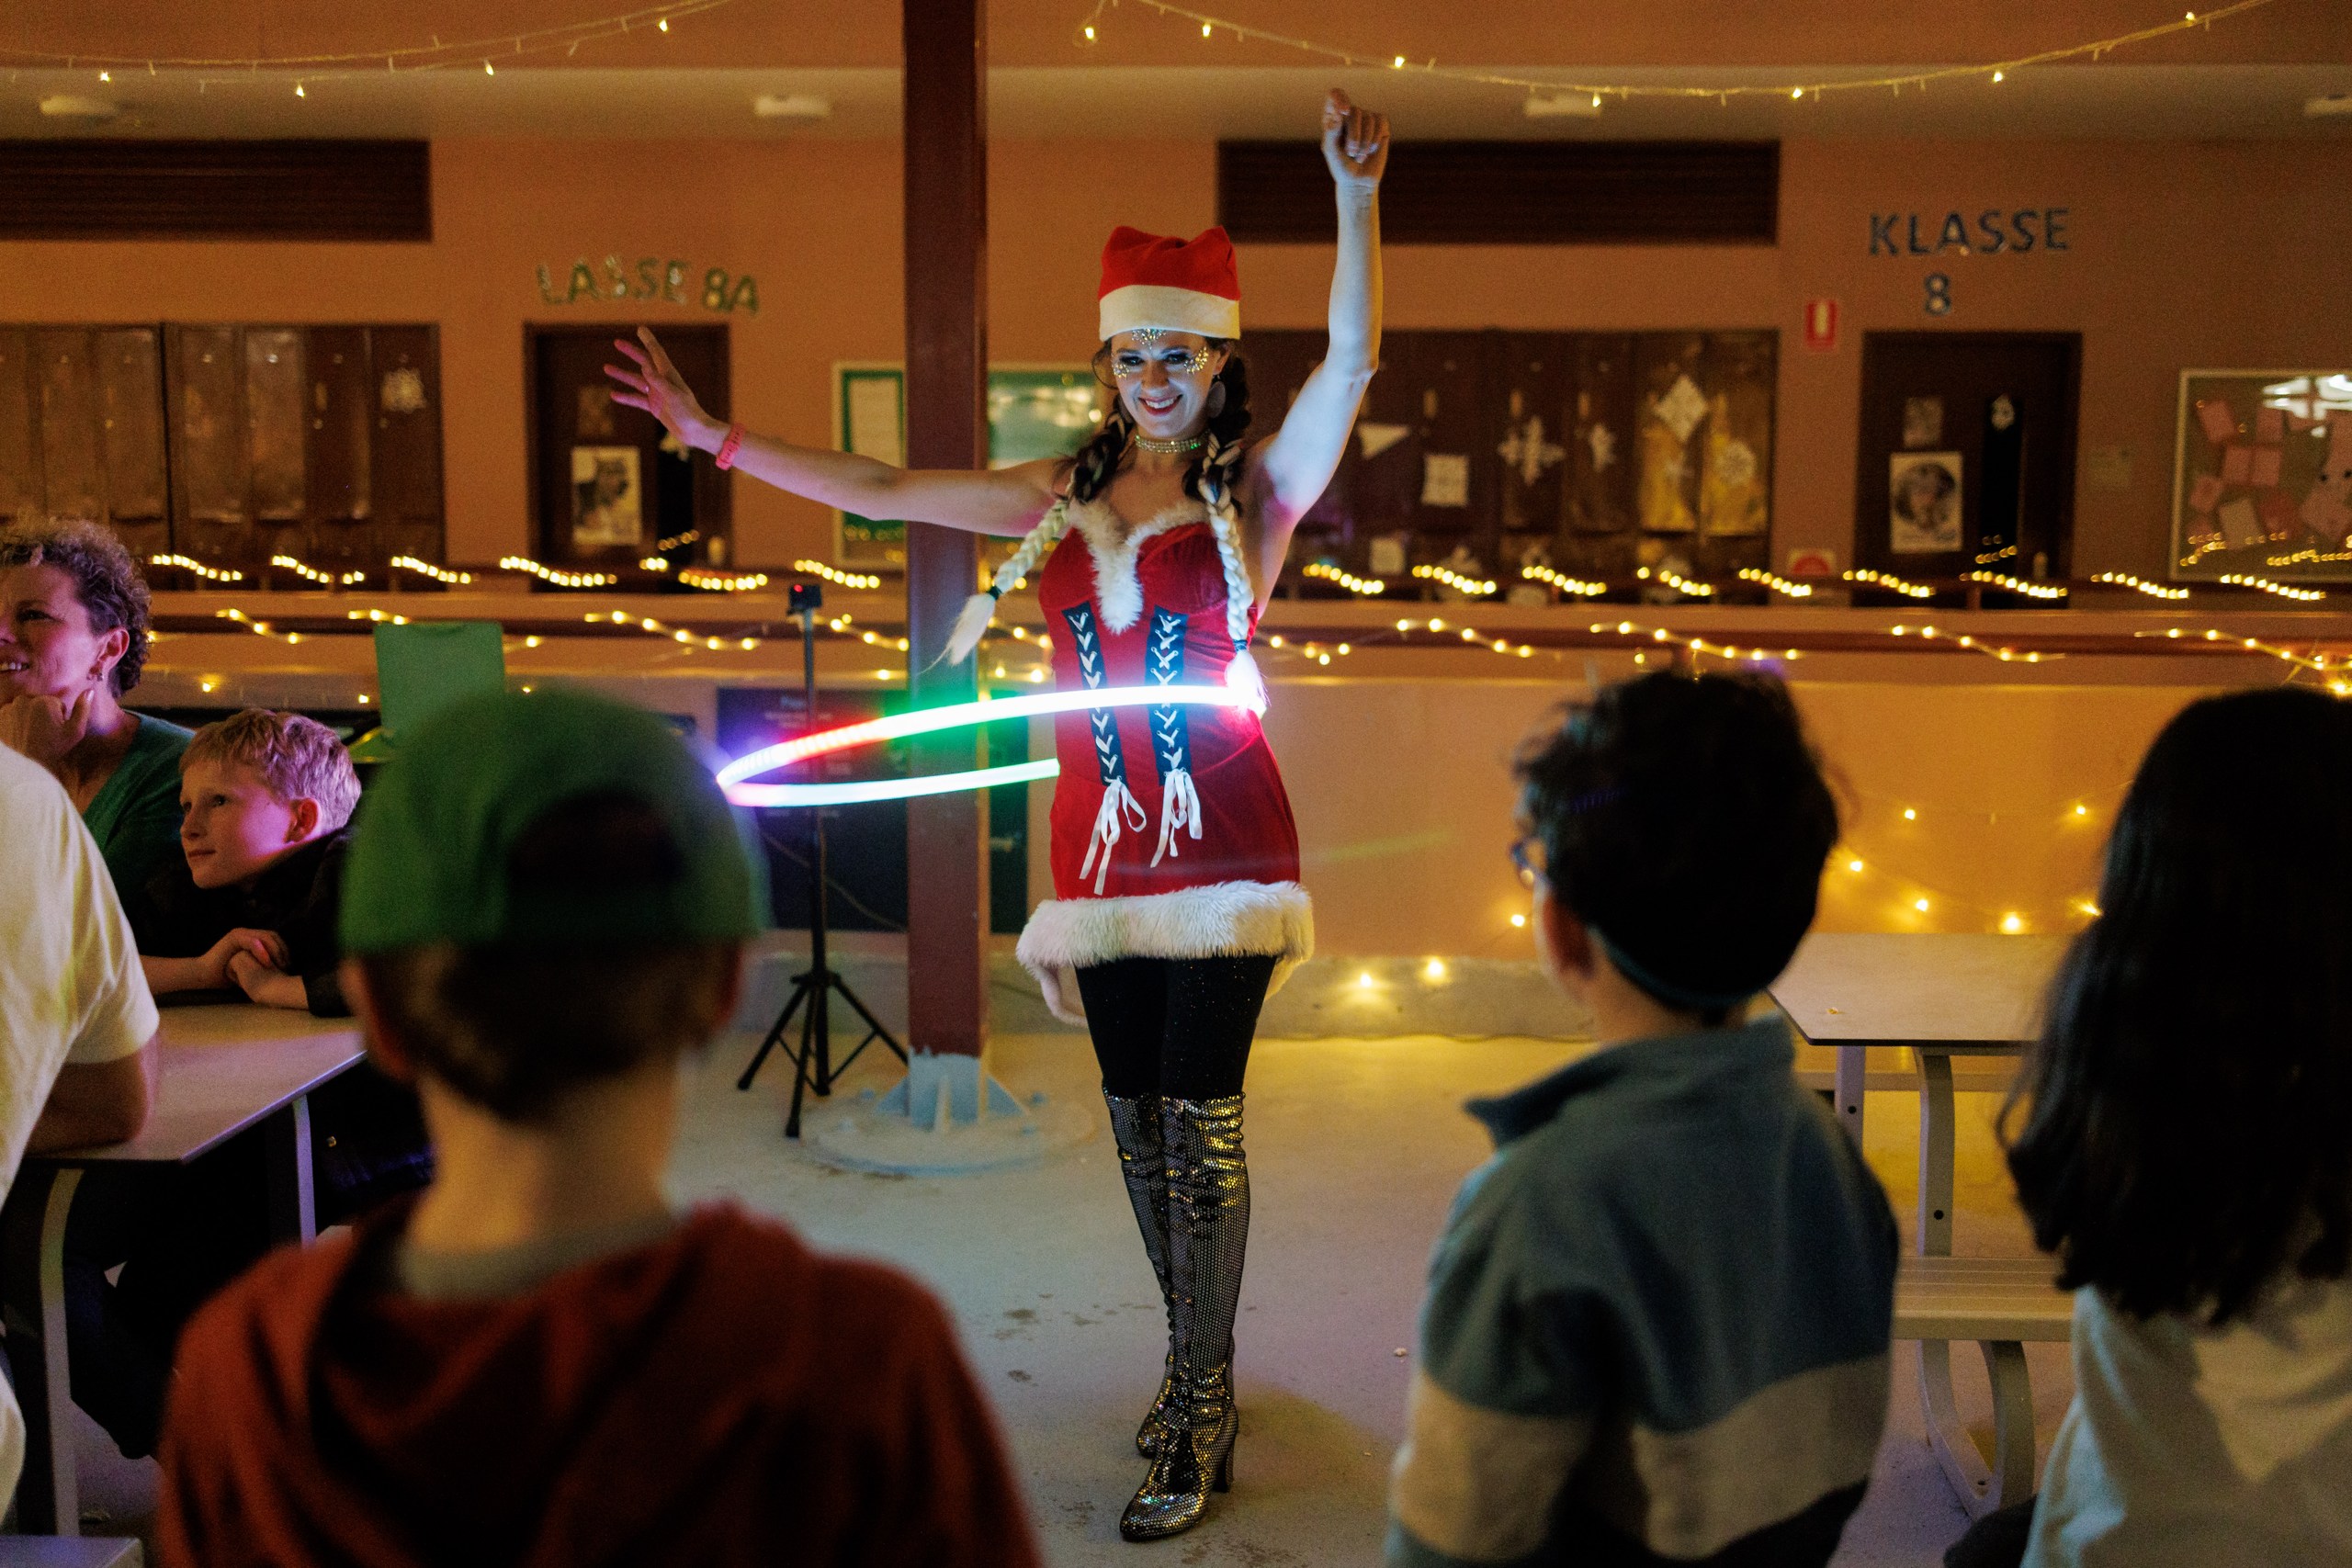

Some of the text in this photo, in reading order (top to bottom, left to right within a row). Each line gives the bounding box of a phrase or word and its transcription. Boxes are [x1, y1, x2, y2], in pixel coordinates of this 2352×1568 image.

[1869, 207, 2070, 255] KLASSE
[537, 256, 760, 317] LASSE 8A
[1924, 273, 1951, 317] 8
